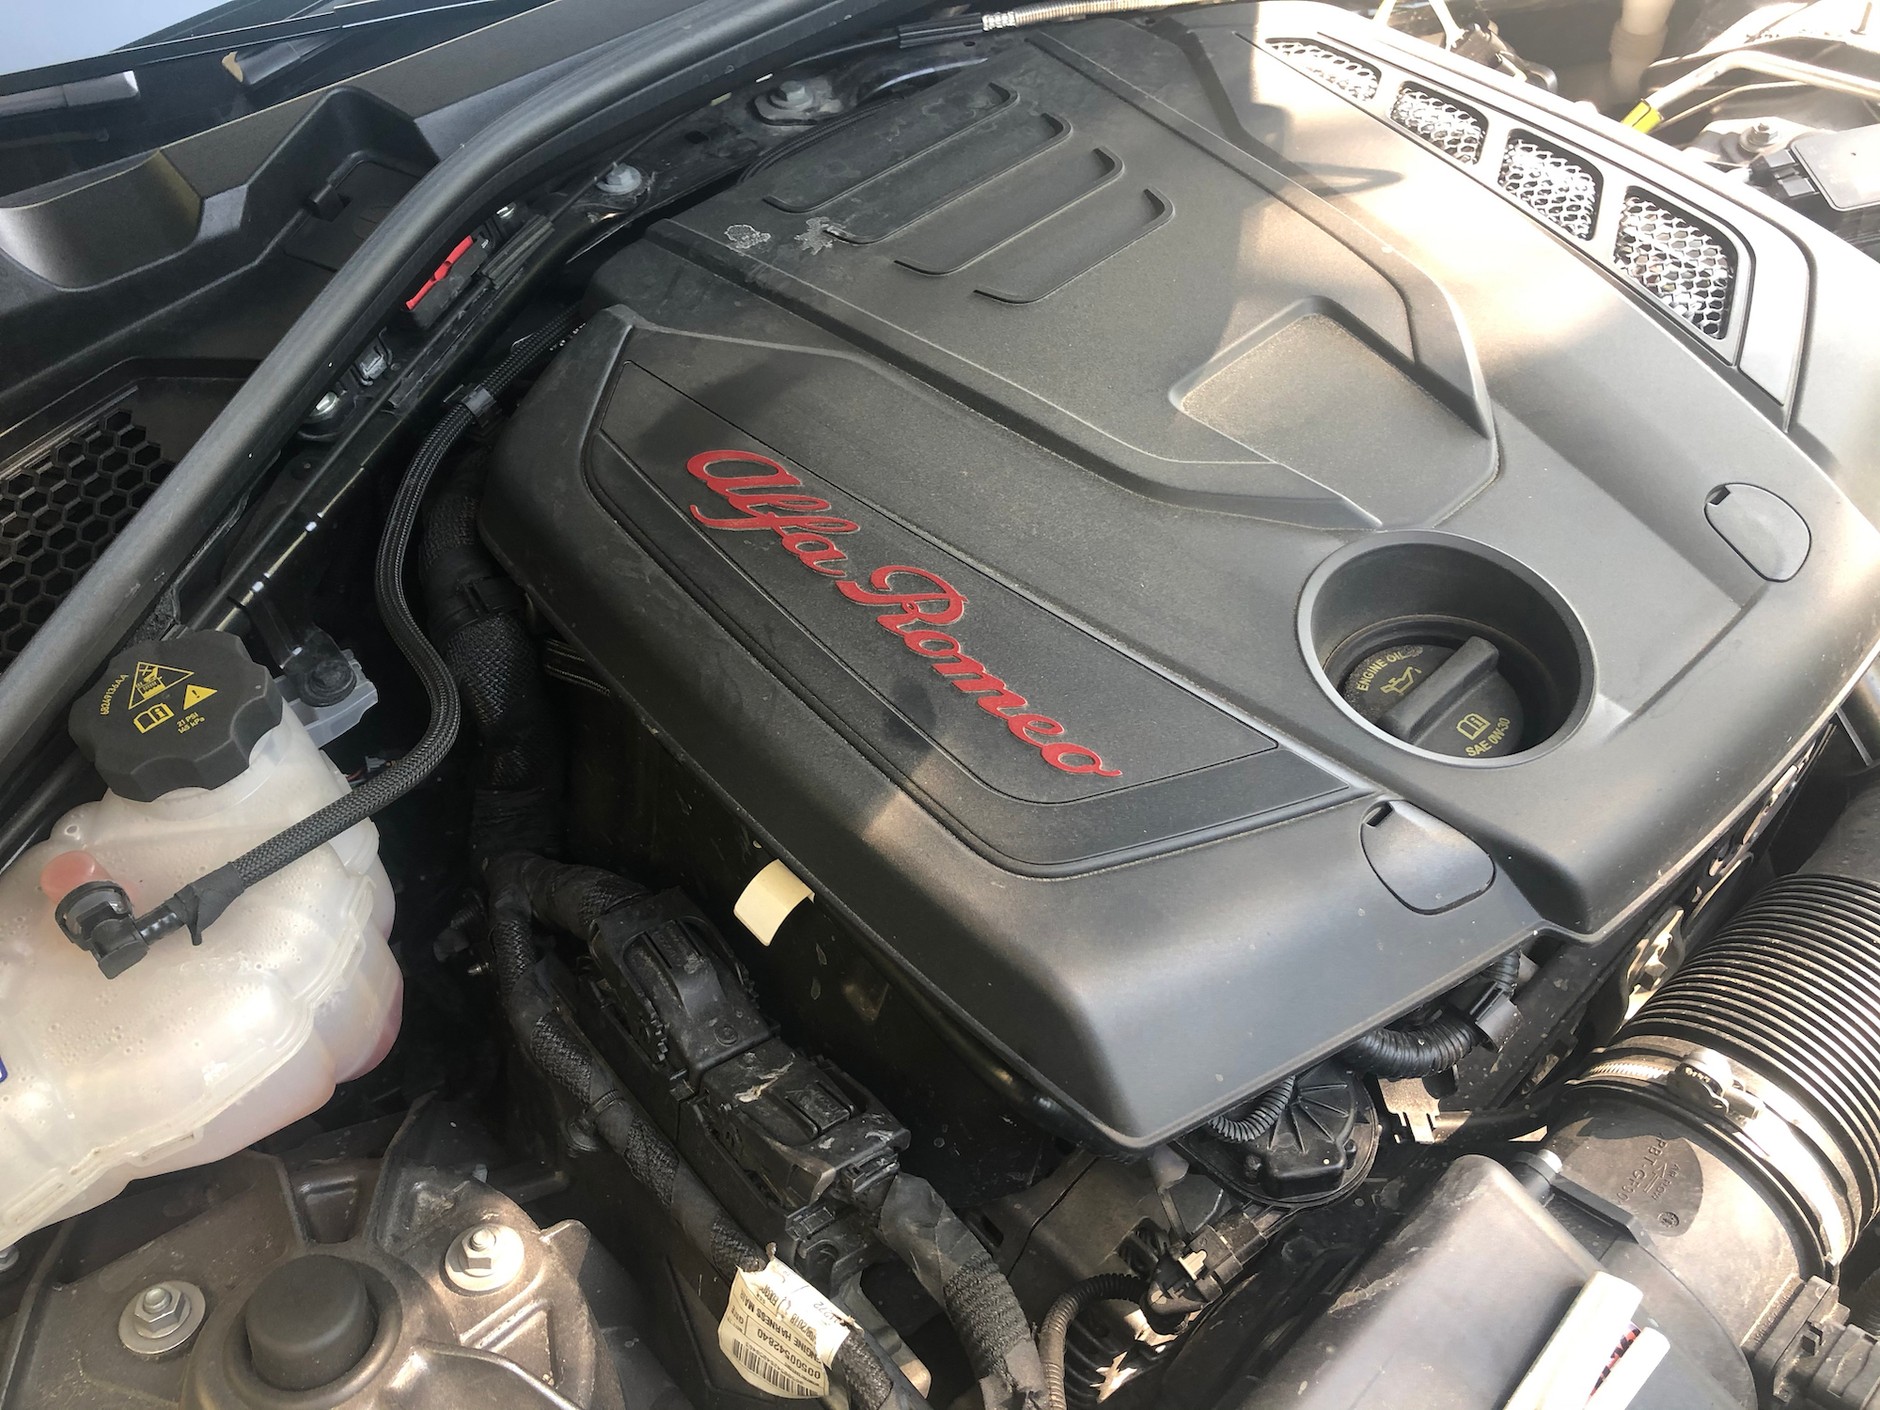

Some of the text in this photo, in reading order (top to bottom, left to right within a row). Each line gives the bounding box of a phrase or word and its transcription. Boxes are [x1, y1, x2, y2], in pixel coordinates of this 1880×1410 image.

[686, 449, 1123, 777] Alfa Romeo
[1357, 651, 1408, 691] ENGINE OIL
[185, 712, 199, 722] PSI
[189, 717, 206, 728] kPa
[1465, 717, 1511, 757] SAE 0W-30
[756, 1307, 792, 1341] HARNESS
[757, 1328, 821, 1379] 00500542840
